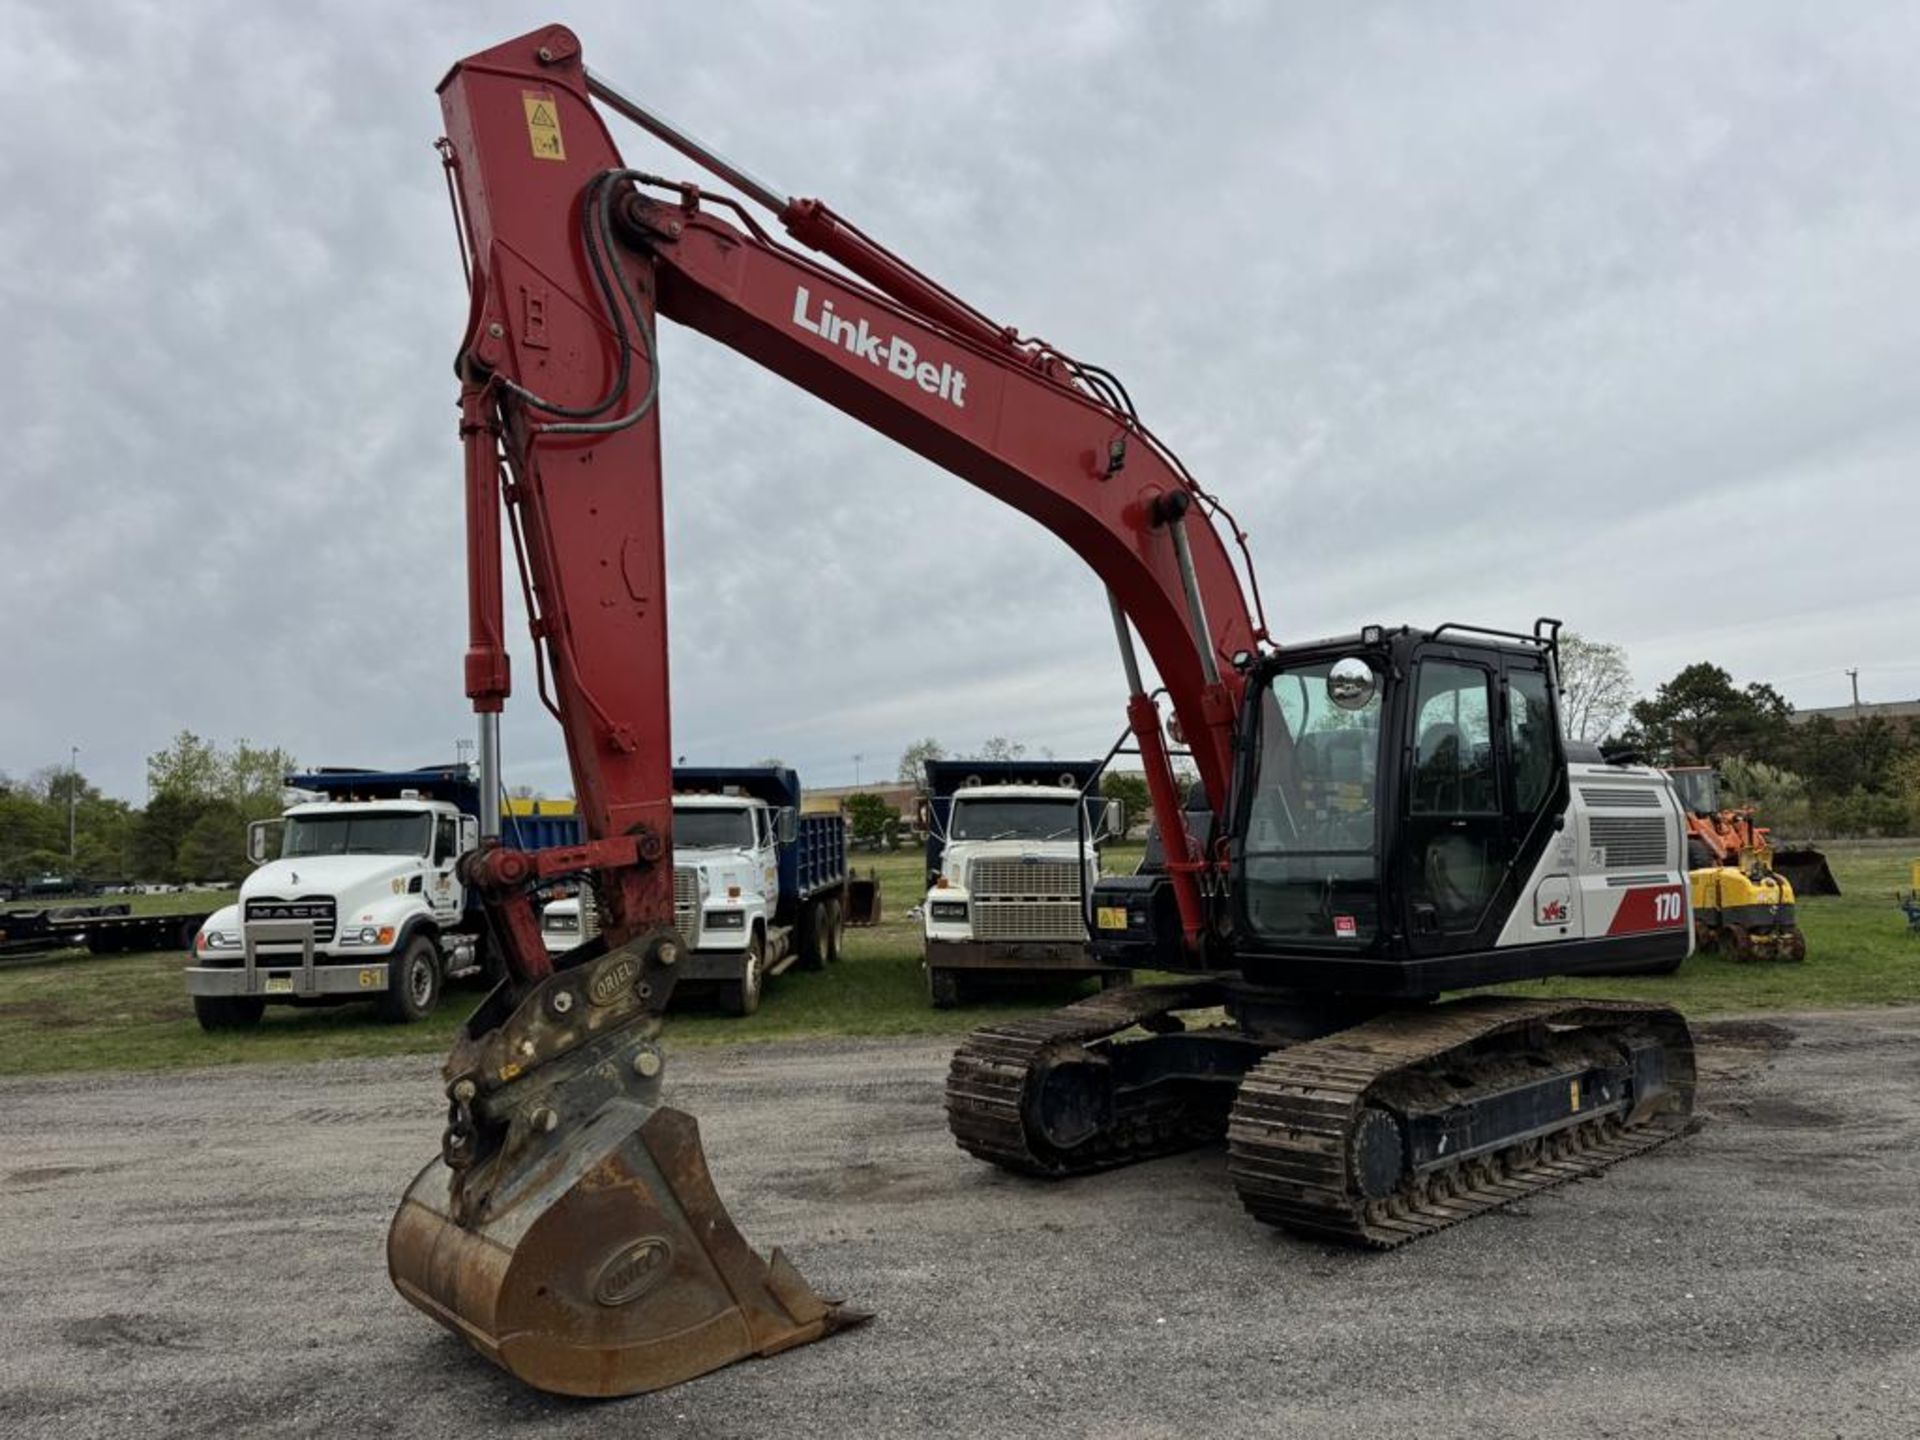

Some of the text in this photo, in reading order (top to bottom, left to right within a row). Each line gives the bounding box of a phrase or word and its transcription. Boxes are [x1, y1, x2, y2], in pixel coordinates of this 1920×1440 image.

[793, 285, 966, 407] Link-Belt
[251, 907, 329, 918] MACK
[1654, 892, 1681, 922] 170
[359, 969, 383, 988] 61
[597, 961, 634, 998] ORIEL
